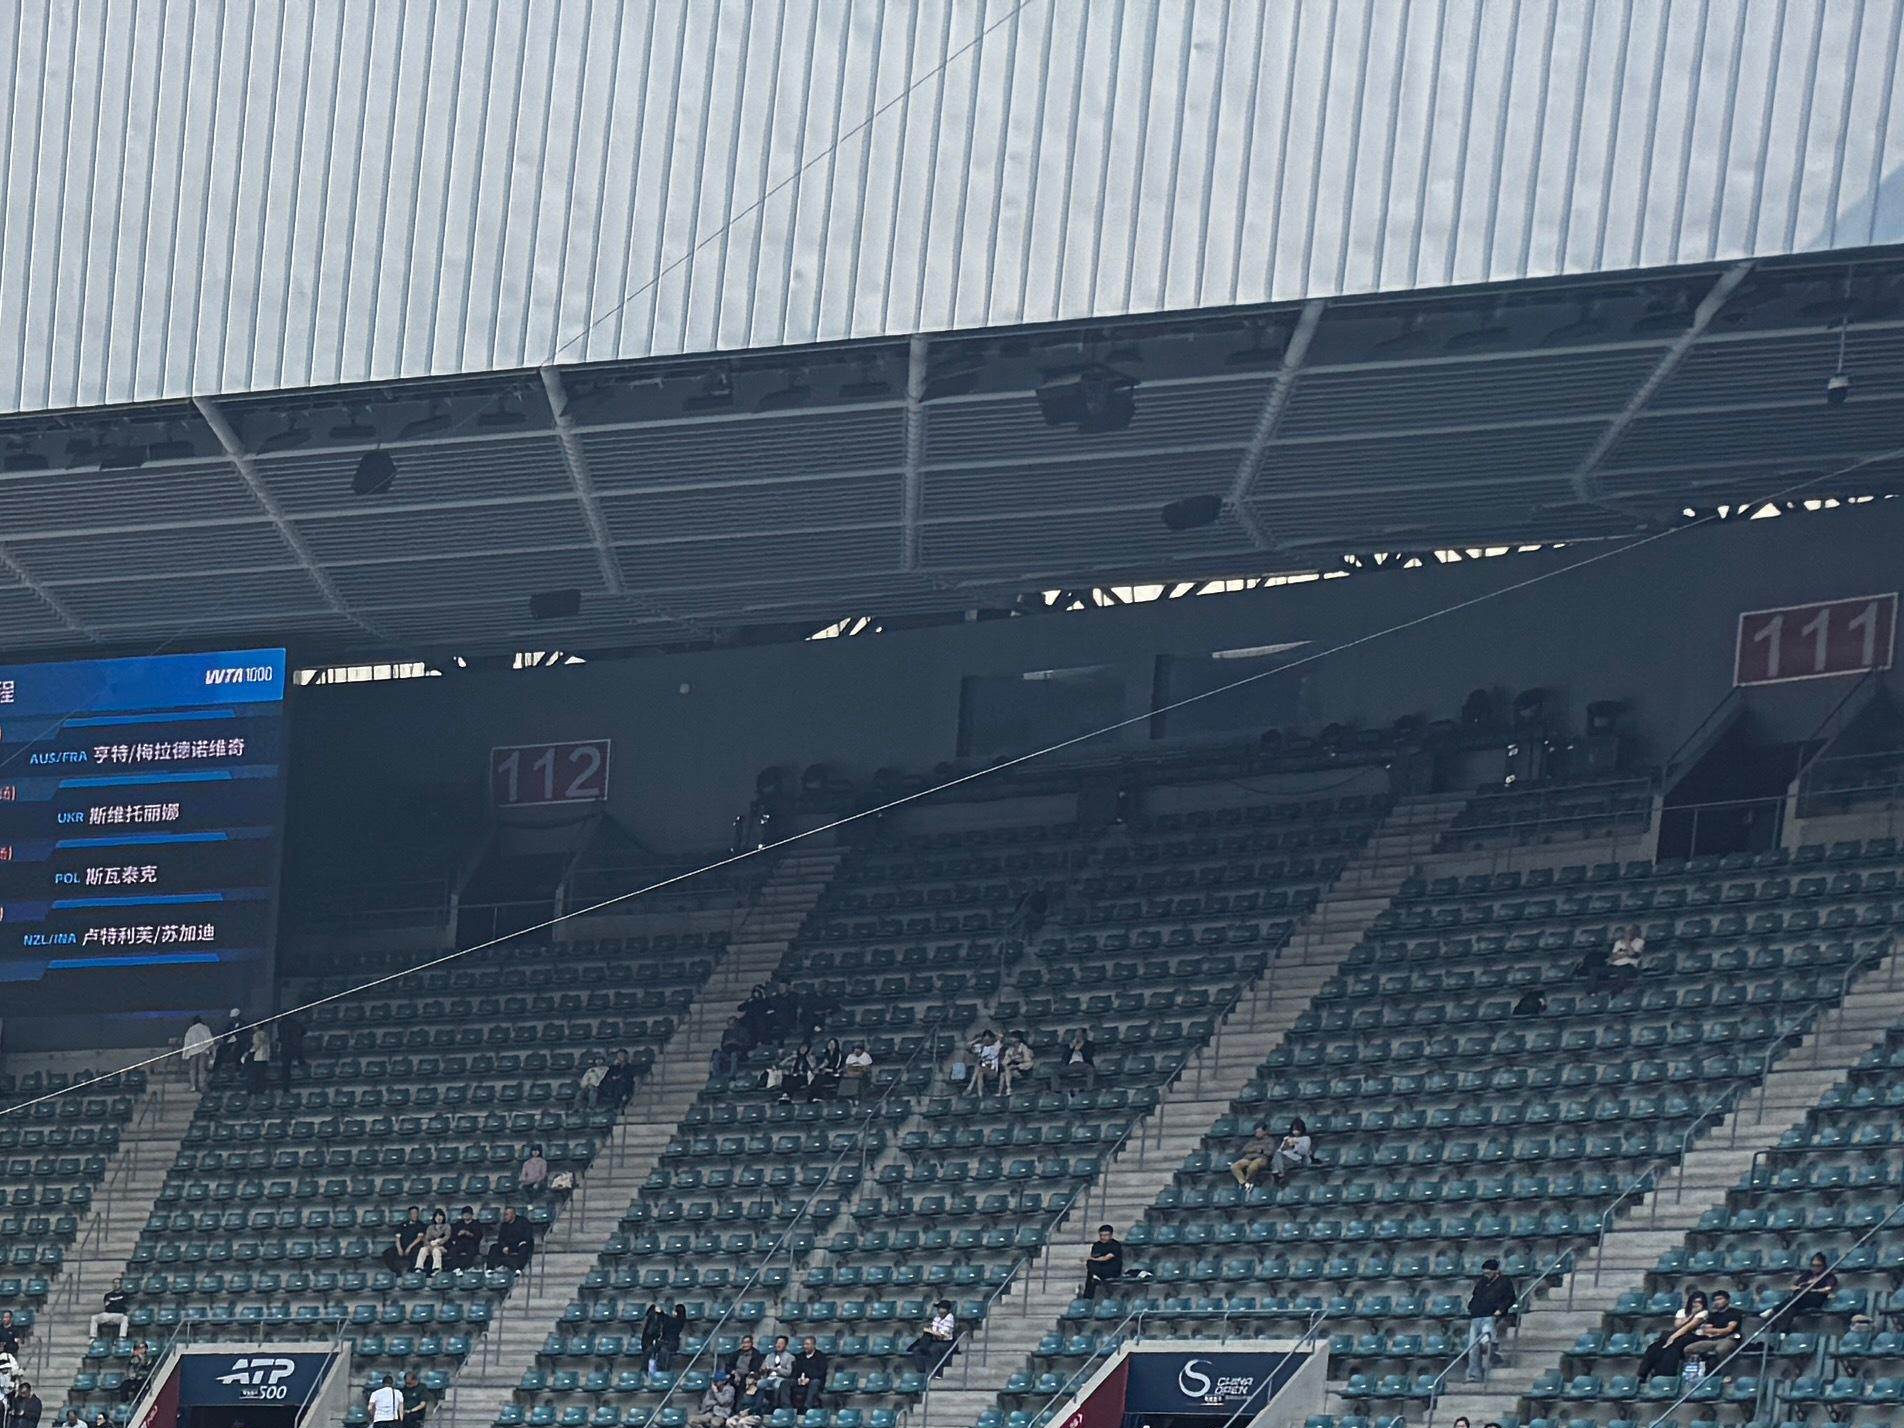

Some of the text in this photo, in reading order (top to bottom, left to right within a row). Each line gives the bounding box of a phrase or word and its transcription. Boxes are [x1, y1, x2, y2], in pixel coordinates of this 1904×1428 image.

[1754, 601, 1879, 678] 111
[205, 666, 272, 685] WTA 1000
[30, 751, 88, 766] AUS/FRA
[498, 747, 601, 802] 112
[57, 811, 84, 824] UKR
[88, 802, 180, 826] 斯维托丽娜
[55, 873, 81, 885] POL
[85, 865, 158, 886] 斯瓦泰克
[24, 933, 77, 946] NZL/INA
[216, 1359, 295, 1385] ATP
[259, 1385, 288, 1399] 500
